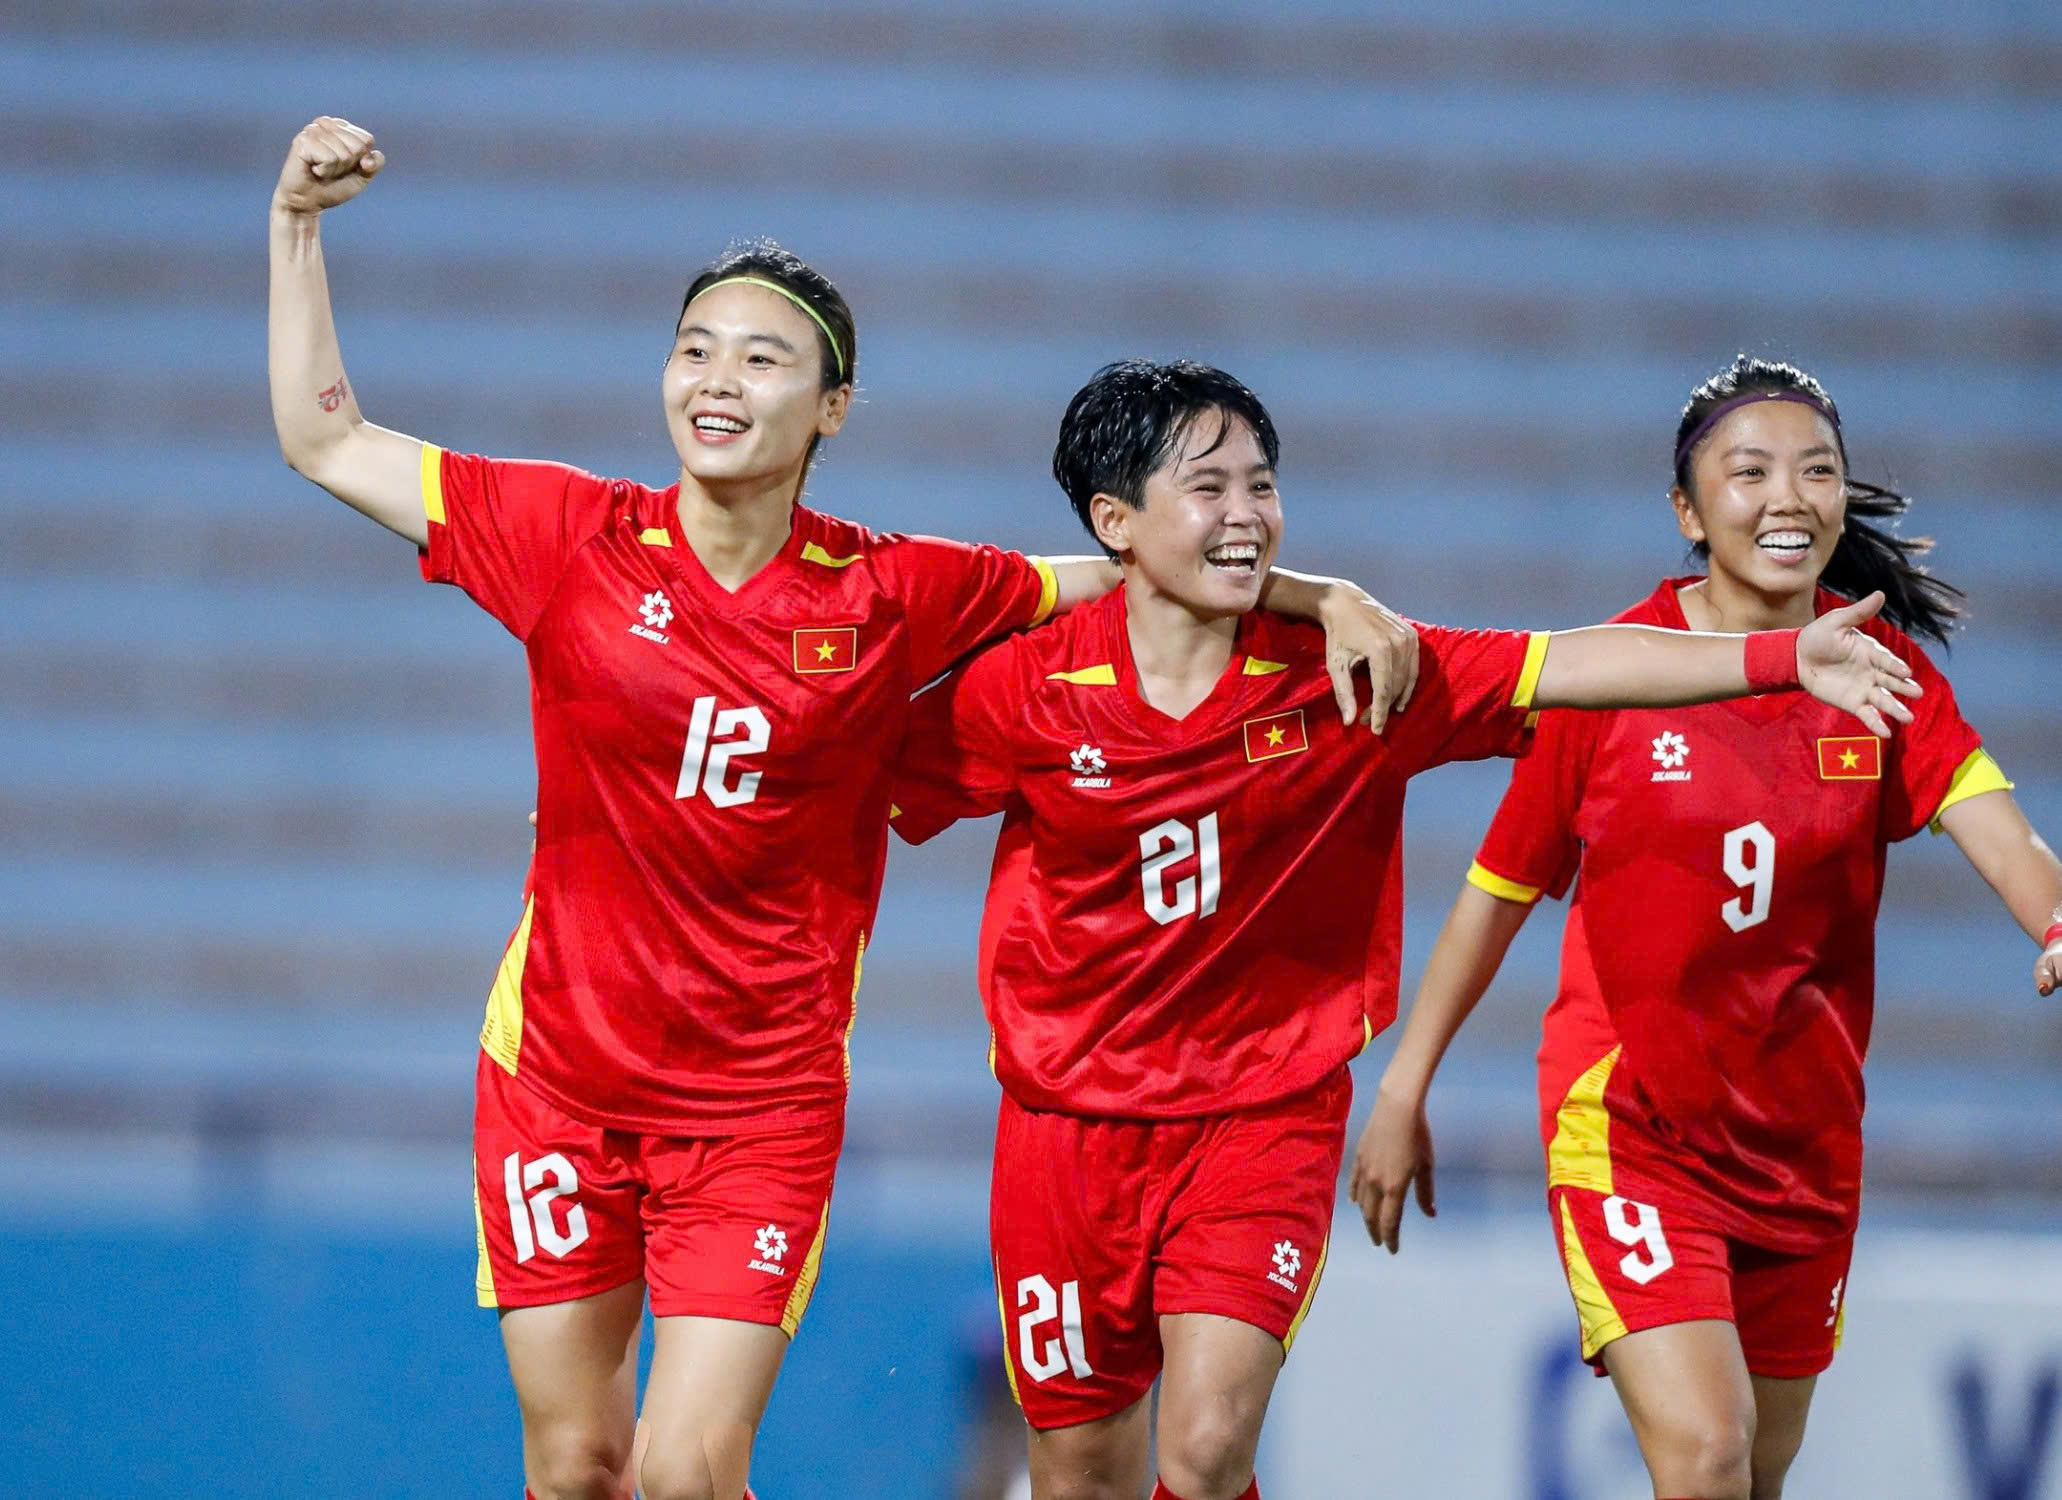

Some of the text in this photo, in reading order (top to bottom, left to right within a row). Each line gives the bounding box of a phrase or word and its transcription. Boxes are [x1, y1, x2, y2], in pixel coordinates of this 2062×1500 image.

[675, 696, 771, 808] 12
[1139, 812, 1220, 925] 21
[1722, 821, 1775, 932] 9
[504, 1152, 589, 1264] 12
[1602, 1195, 1674, 1285] 9
[1018, 1274, 1092, 1382] 21
